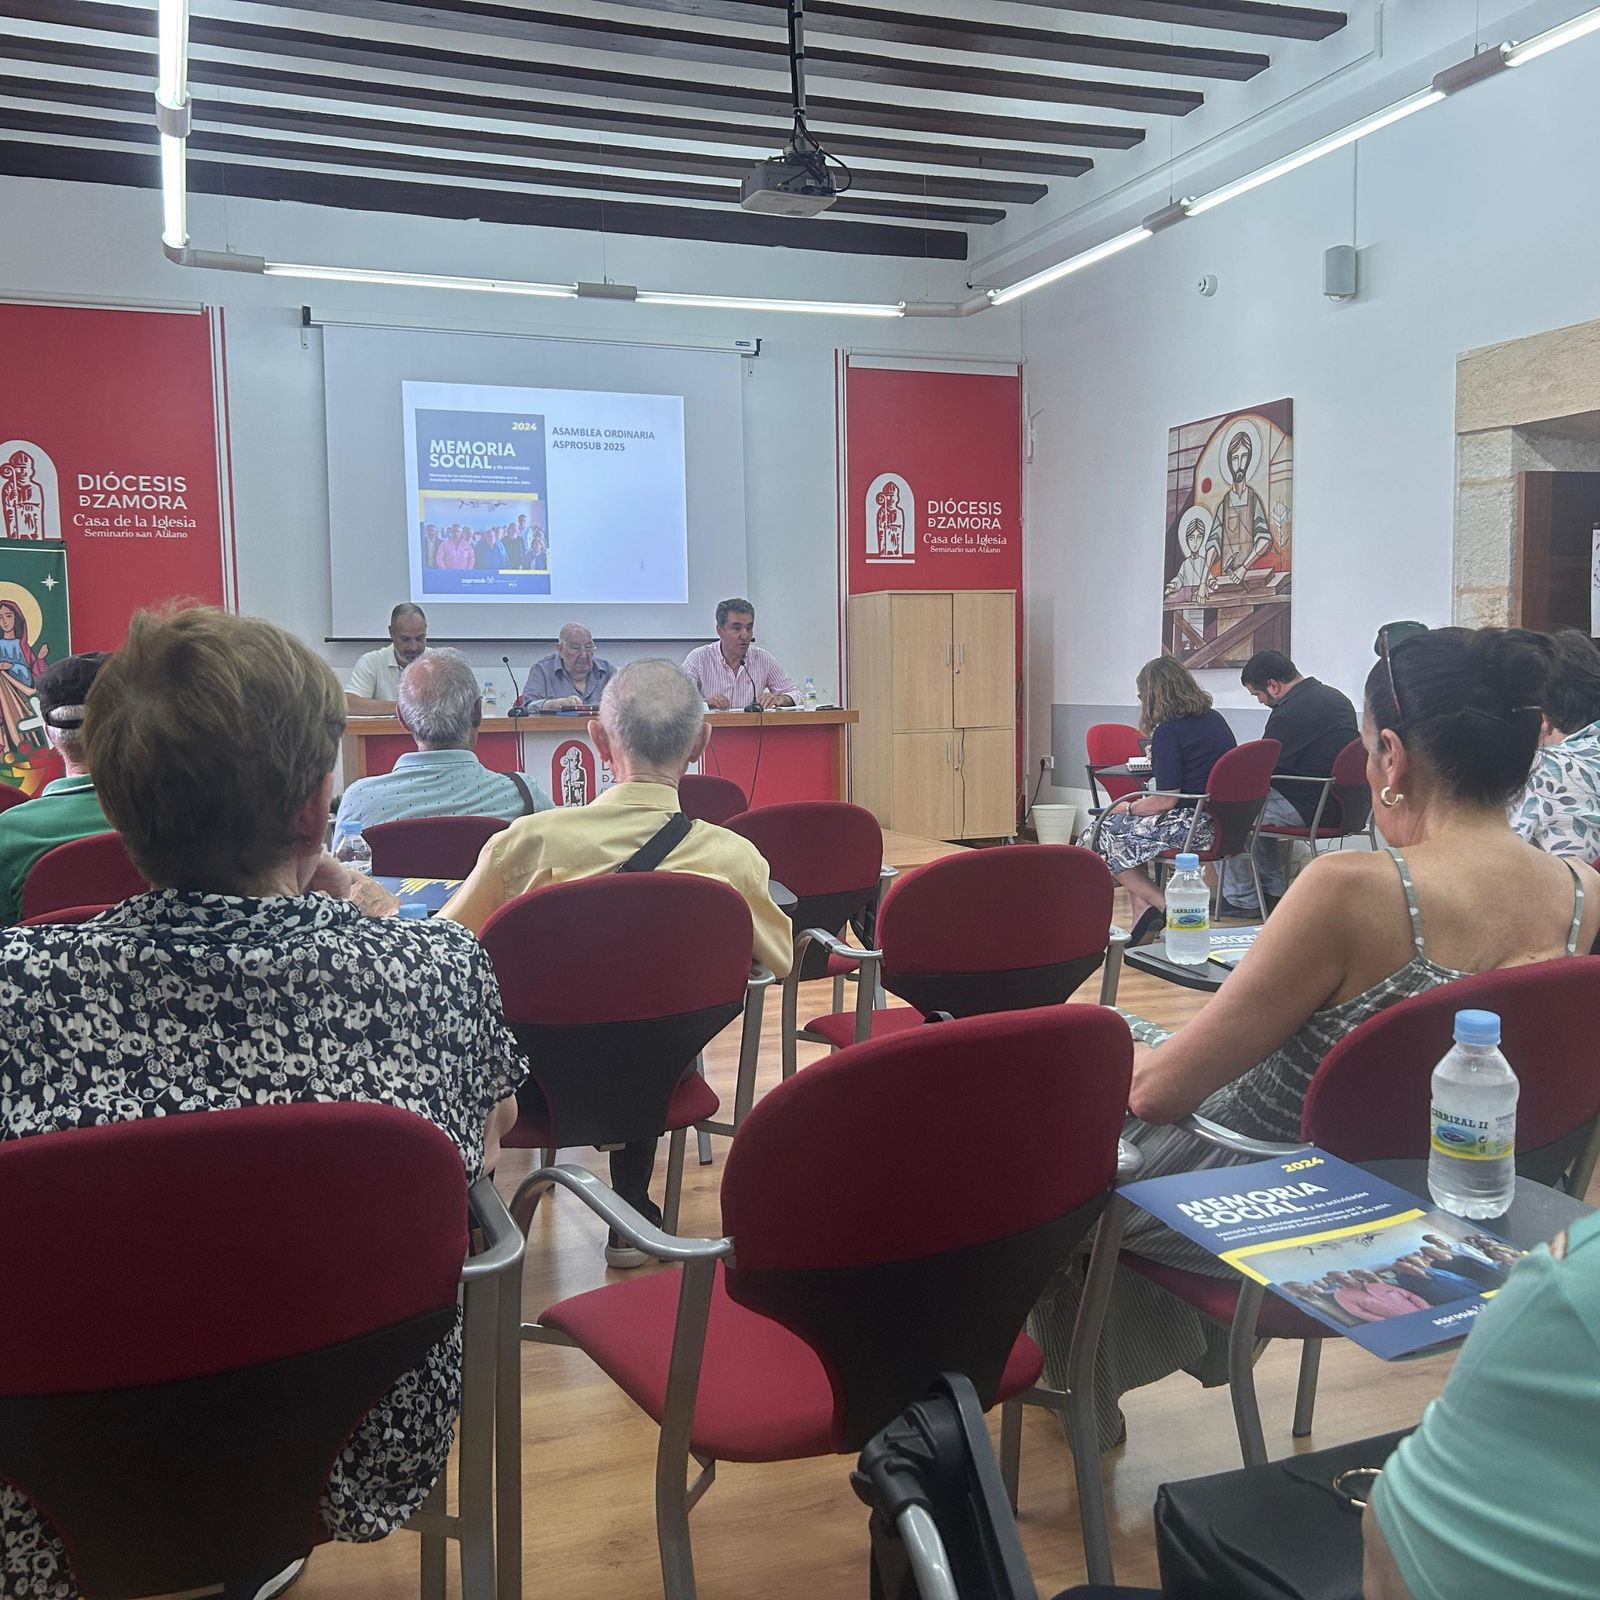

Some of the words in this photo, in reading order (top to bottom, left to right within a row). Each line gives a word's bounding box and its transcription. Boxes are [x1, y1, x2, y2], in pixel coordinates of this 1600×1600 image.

[512, 422, 537, 431] 2024
[552, 427, 602, 437] ASAMBLEA
[604, 429, 655, 439] ORDINARIA
[430, 439, 516, 456] MEMORIA
[552, 440, 601, 450] ASPROSUB
[603, 442, 625, 451] 2025
[429, 454, 492, 469] SOCIAL
[78, 471, 187, 492] DIÓCESIS
[927, 498, 1002, 515] DIÓCESIS
[73, 514, 110, 527] Casa
[114, 514, 132, 527] de
[135, 515, 147, 527] la
[152, 515, 197, 530] Iglesia
[84, 529, 134, 538] Seminario
[923, 533, 948, 544] Casa
[951, 534, 963, 544] de
[965, 534, 973, 544] la
[976, 534, 1007, 547] Iglesia
[1281, 1156, 1324, 1173] 2024
[1177, 1182, 1329, 1217] MEMORIA
[1193, 1200, 1308, 1228] SOCIAL
[1325, 1191, 1370, 1206] actividades
